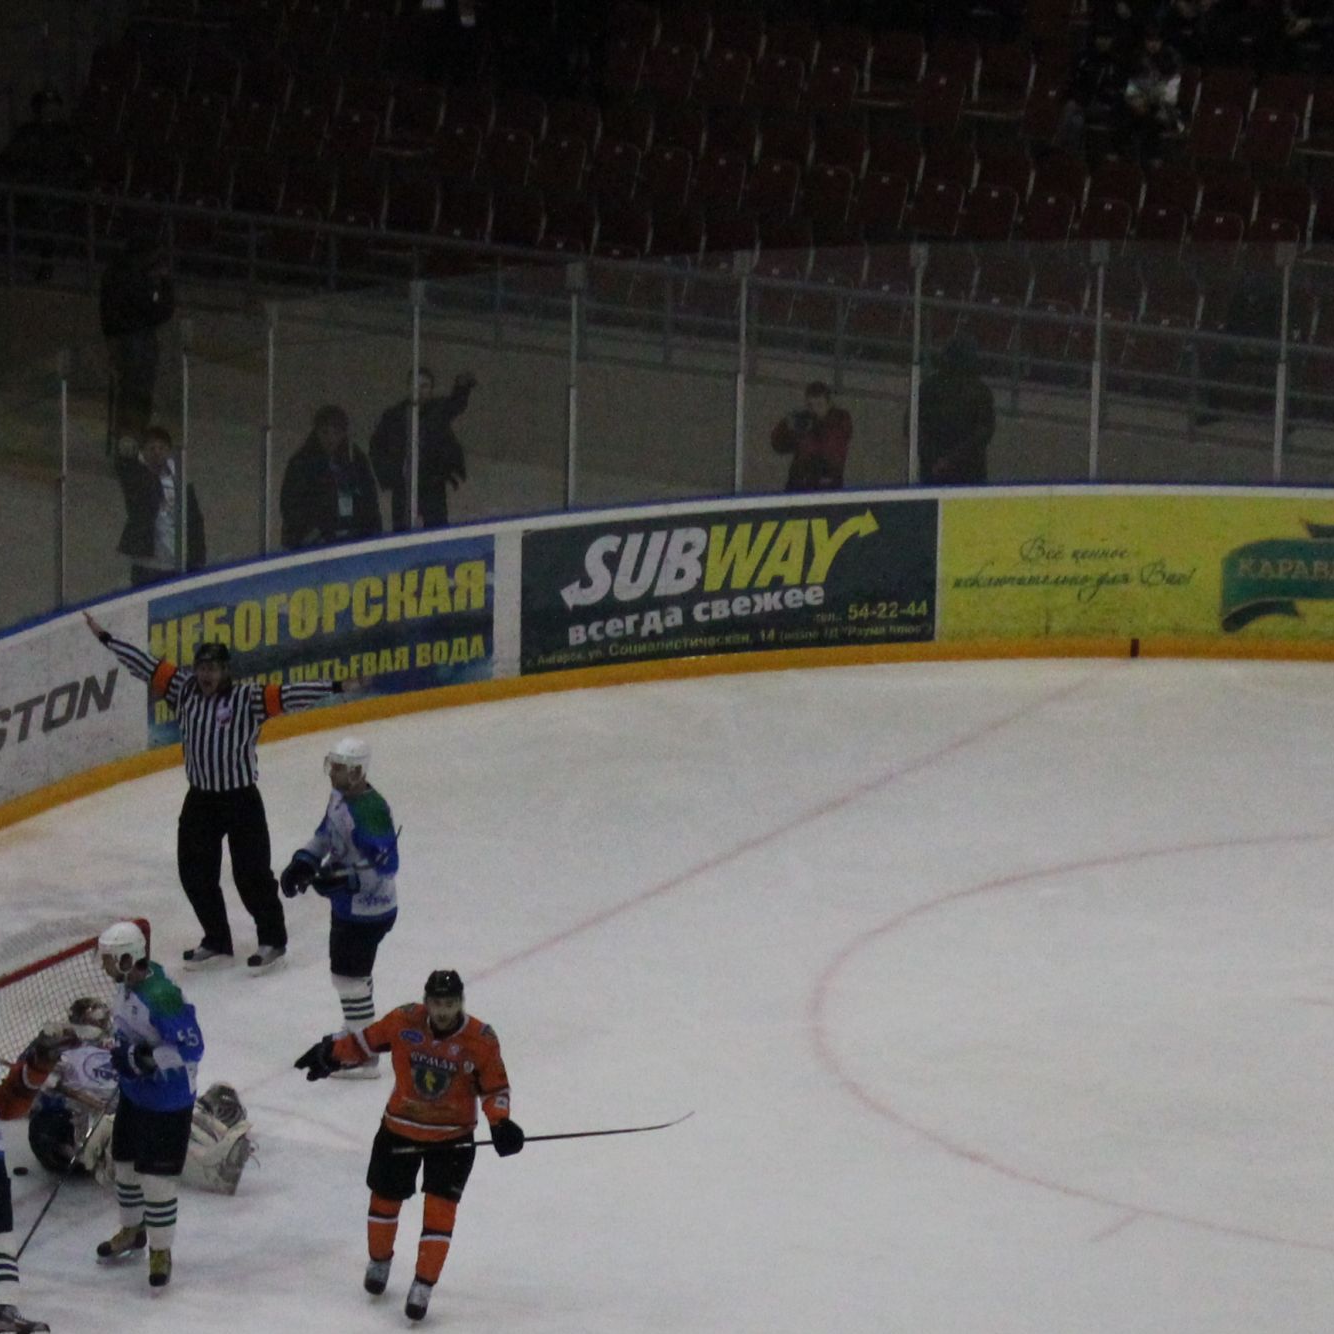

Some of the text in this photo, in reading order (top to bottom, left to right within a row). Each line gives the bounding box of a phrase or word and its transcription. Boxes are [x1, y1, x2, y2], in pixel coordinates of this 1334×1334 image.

[560, 510, 881, 610] SUBWAY
[569, 584, 825, 647] всегда свежее
[848, 600, 928, 620] 54-22-44
[289, 650, 409, 685] ПИТЬЕВАЯ
[417, 634, 486, 668] ВОДА
